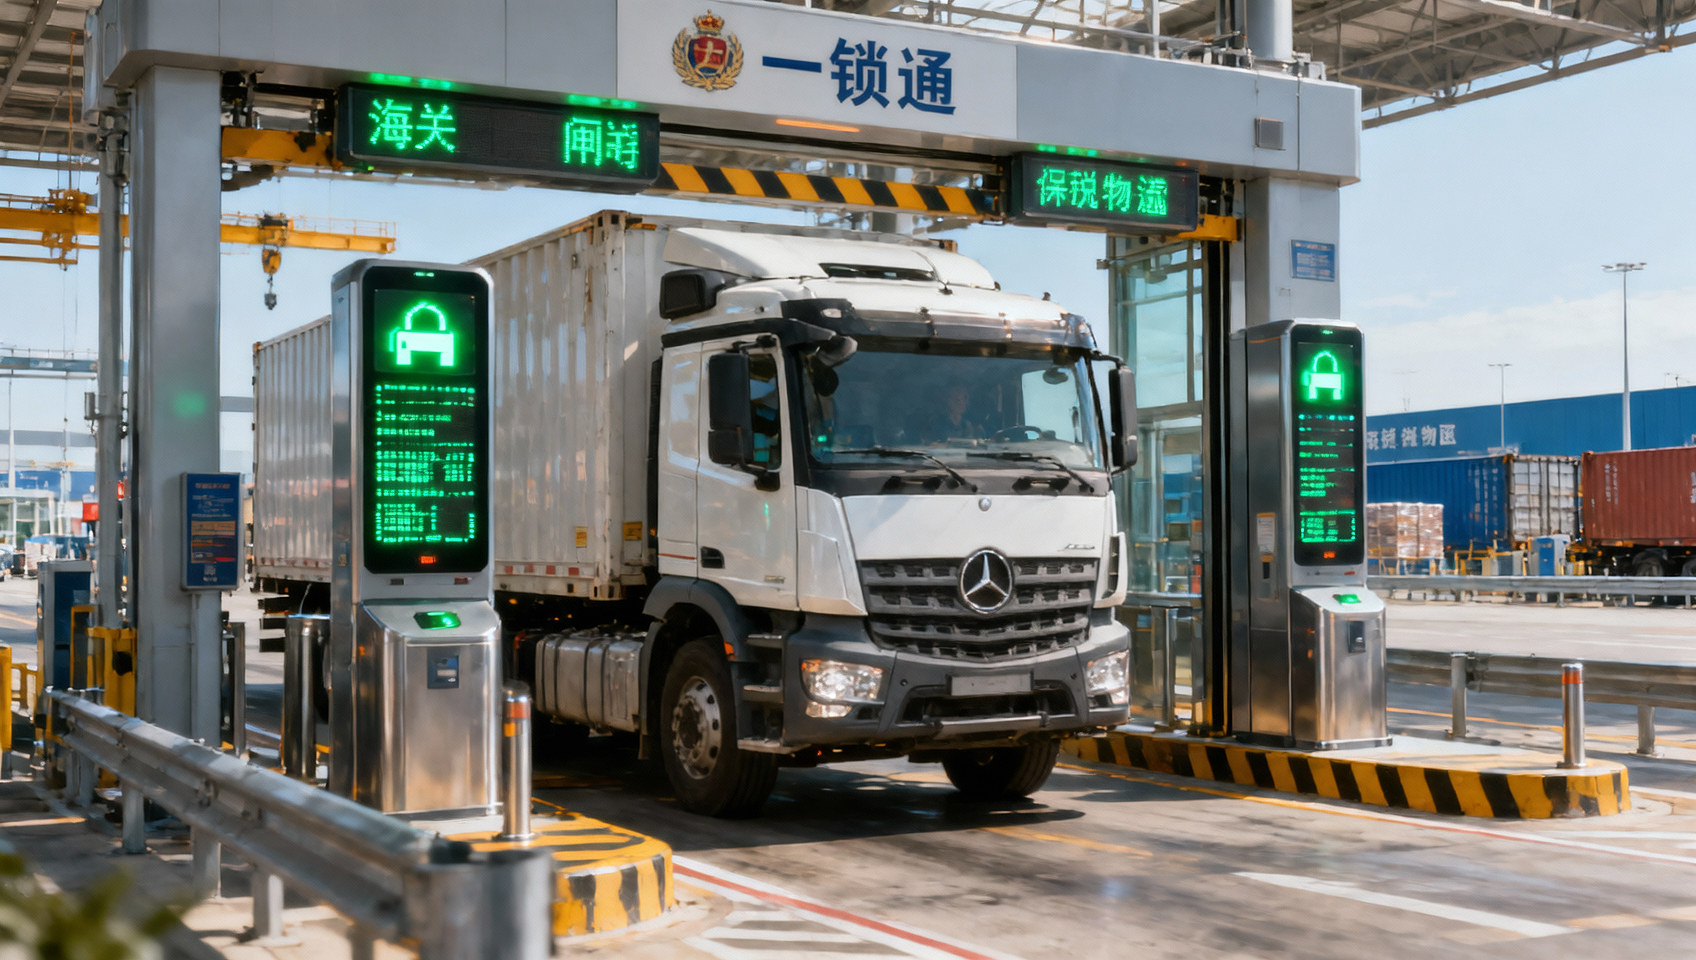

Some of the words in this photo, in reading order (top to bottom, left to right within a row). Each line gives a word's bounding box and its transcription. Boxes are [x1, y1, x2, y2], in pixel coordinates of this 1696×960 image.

[762, 37, 957, 116] 一锁通
[368, 98, 456, 153] 海关
